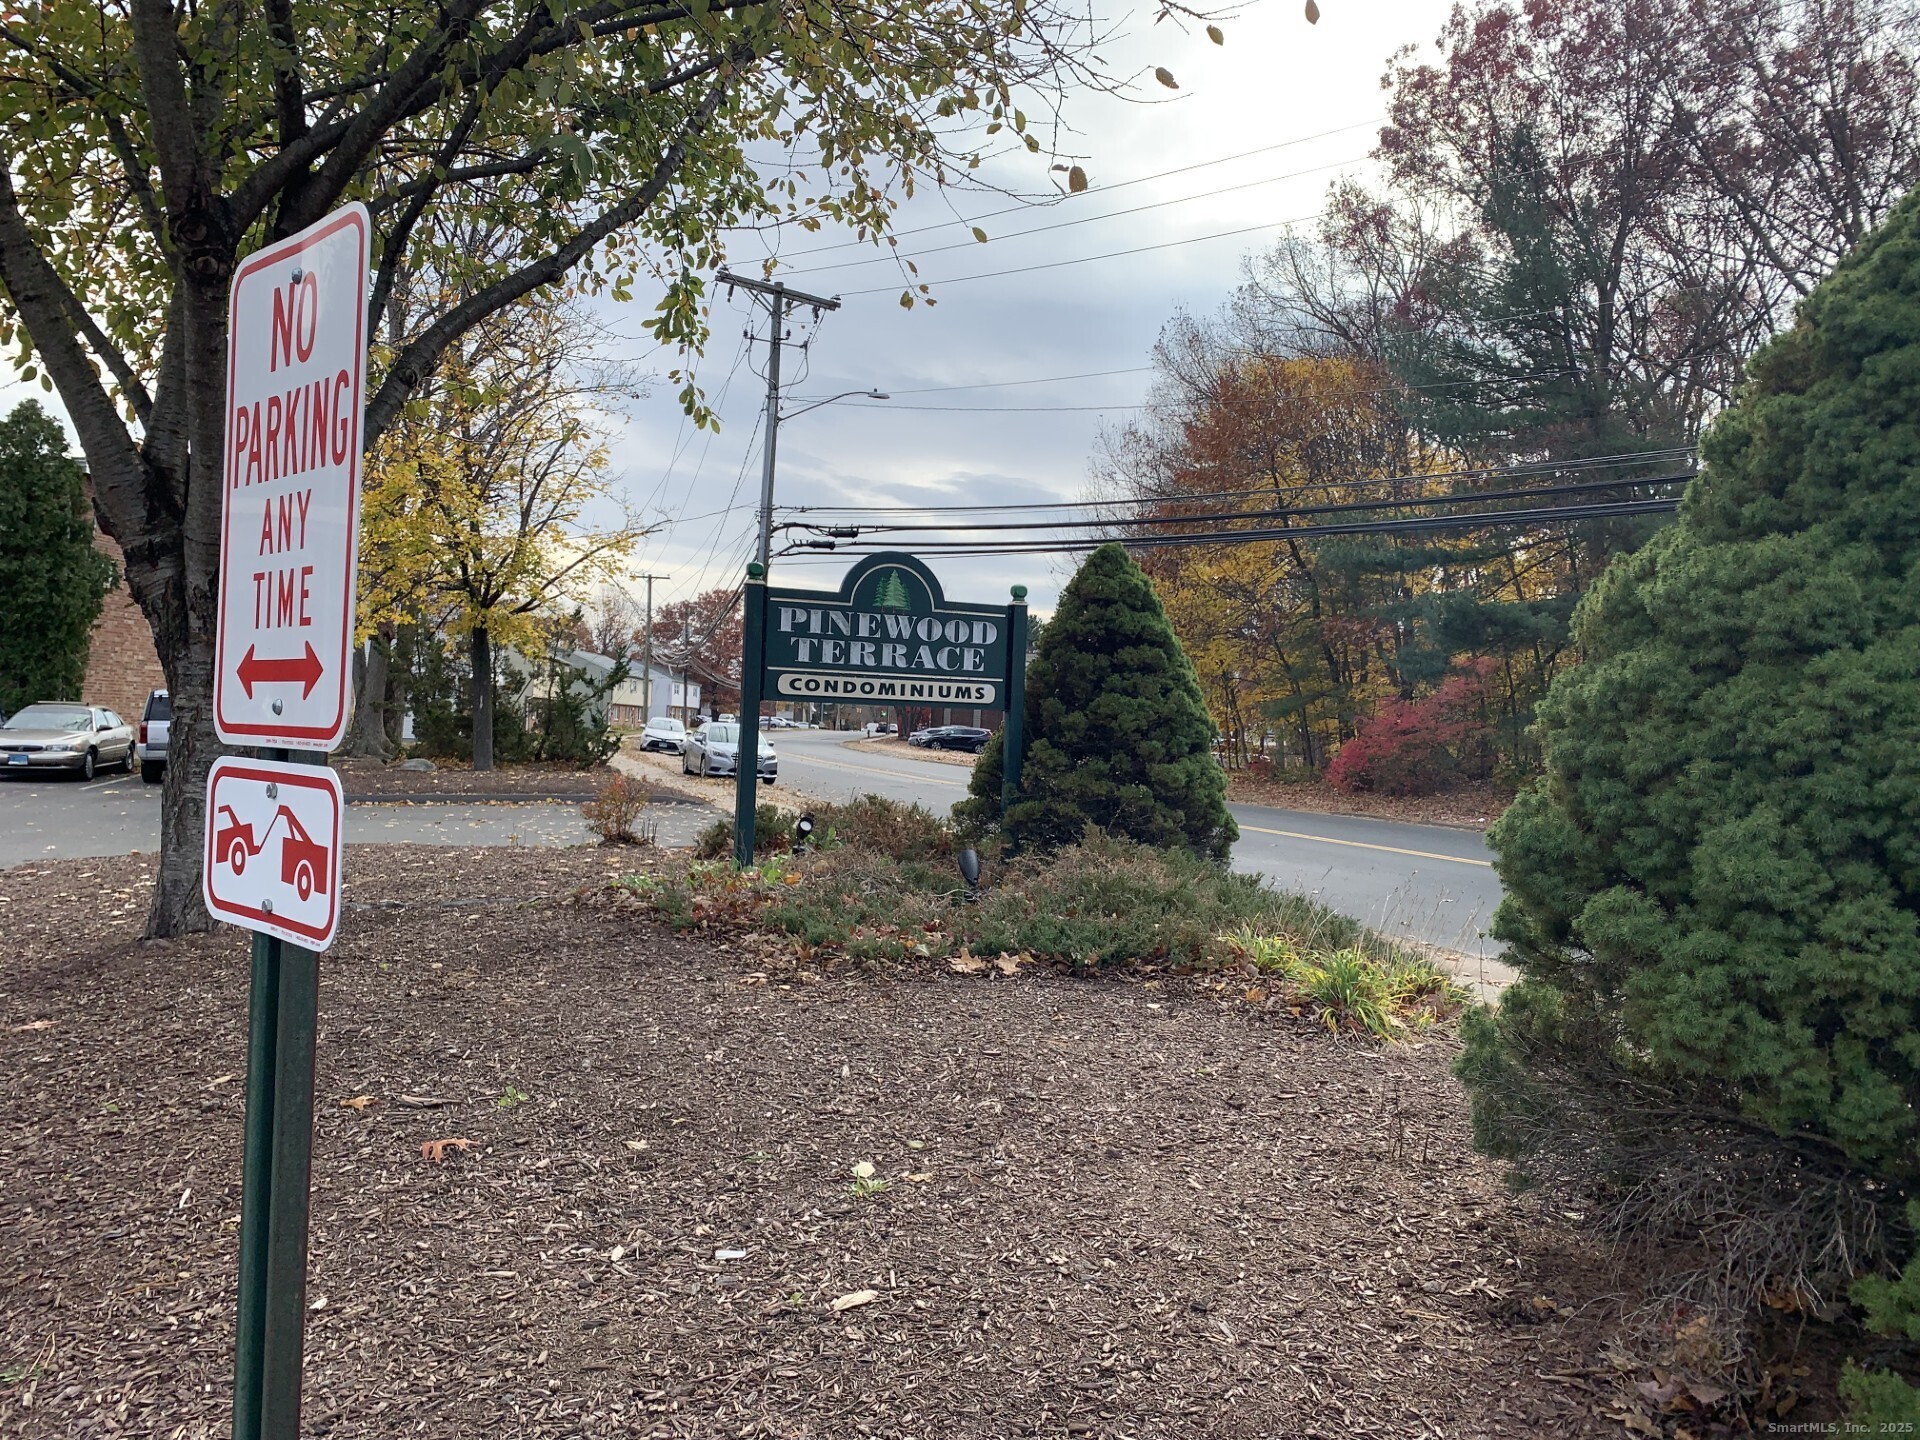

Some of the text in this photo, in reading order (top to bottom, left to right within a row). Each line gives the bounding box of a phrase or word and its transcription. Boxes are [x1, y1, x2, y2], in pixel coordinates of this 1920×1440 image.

[271, 271, 318, 372] NO
[233, 369, 350, 489] PARKING
[259, 488, 312, 556] ANY
[253, 565, 314, 629] TIME
[777, 606, 998, 645] PINEWOOD
[790, 636, 985, 672] TERRACE
[789, 677, 985, 700] CONDOMINIUMS
